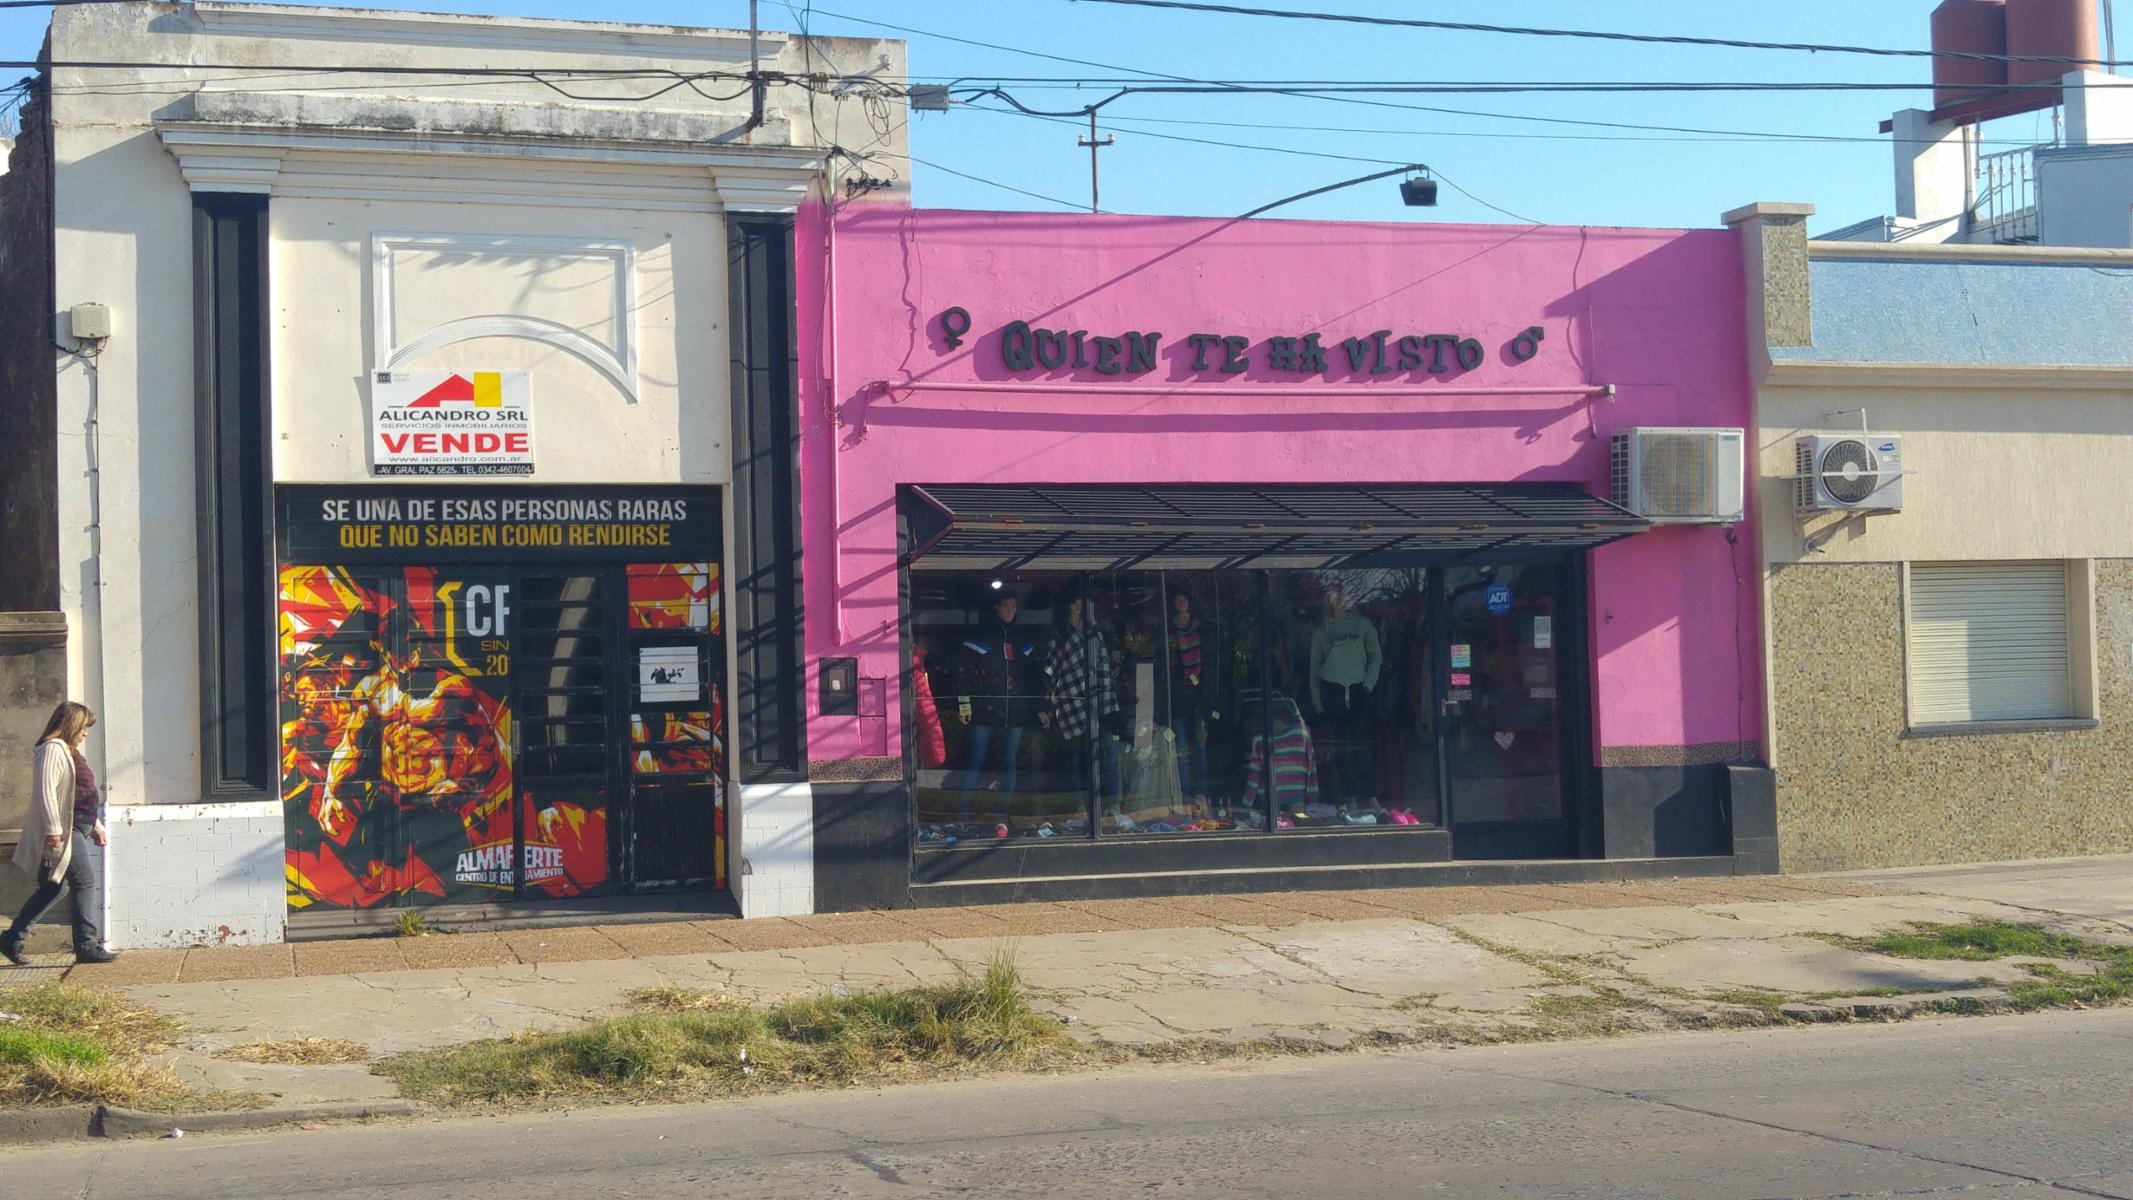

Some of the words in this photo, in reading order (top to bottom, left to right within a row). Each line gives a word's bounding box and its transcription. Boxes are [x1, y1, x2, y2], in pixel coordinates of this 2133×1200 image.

[1002, 319, 1162, 375] QUIEN
[1188, 333, 1249, 373] TE
[1269, 332, 1328, 373] HA
[1343, 329, 1484, 375] VISTO
[379, 410, 490, 421] ALICANDRO
[496, 410, 528, 421] SRL
[380, 432, 529, 454] VENDE
[388, 455, 521, 463] www.alicandro.com.ar
[394, 465, 417, 474] GRAL
[419, 465, 435, 474] PAZ
[322, 499, 350, 521] SE
[356, 499, 401, 521] UNA
[408, 499, 435, 521] DE
[442, 499, 497, 521] ESAS
[502, 499, 613, 521] PERSONAS
[618, 499, 687, 521] RARAS
[339, 524, 383, 548] QUE
[389, 524, 419, 547] NO
[425, 524, 497, 546] SABEN
[502, 524, 563, 546] COMO
[568, 524, 671, 546] RENDIRSE
[1490, 591, 1508, 604] ADT
[456, 844, 563, 872] ALMAFERTE
[456, 871, 487, 882] CENTRO
